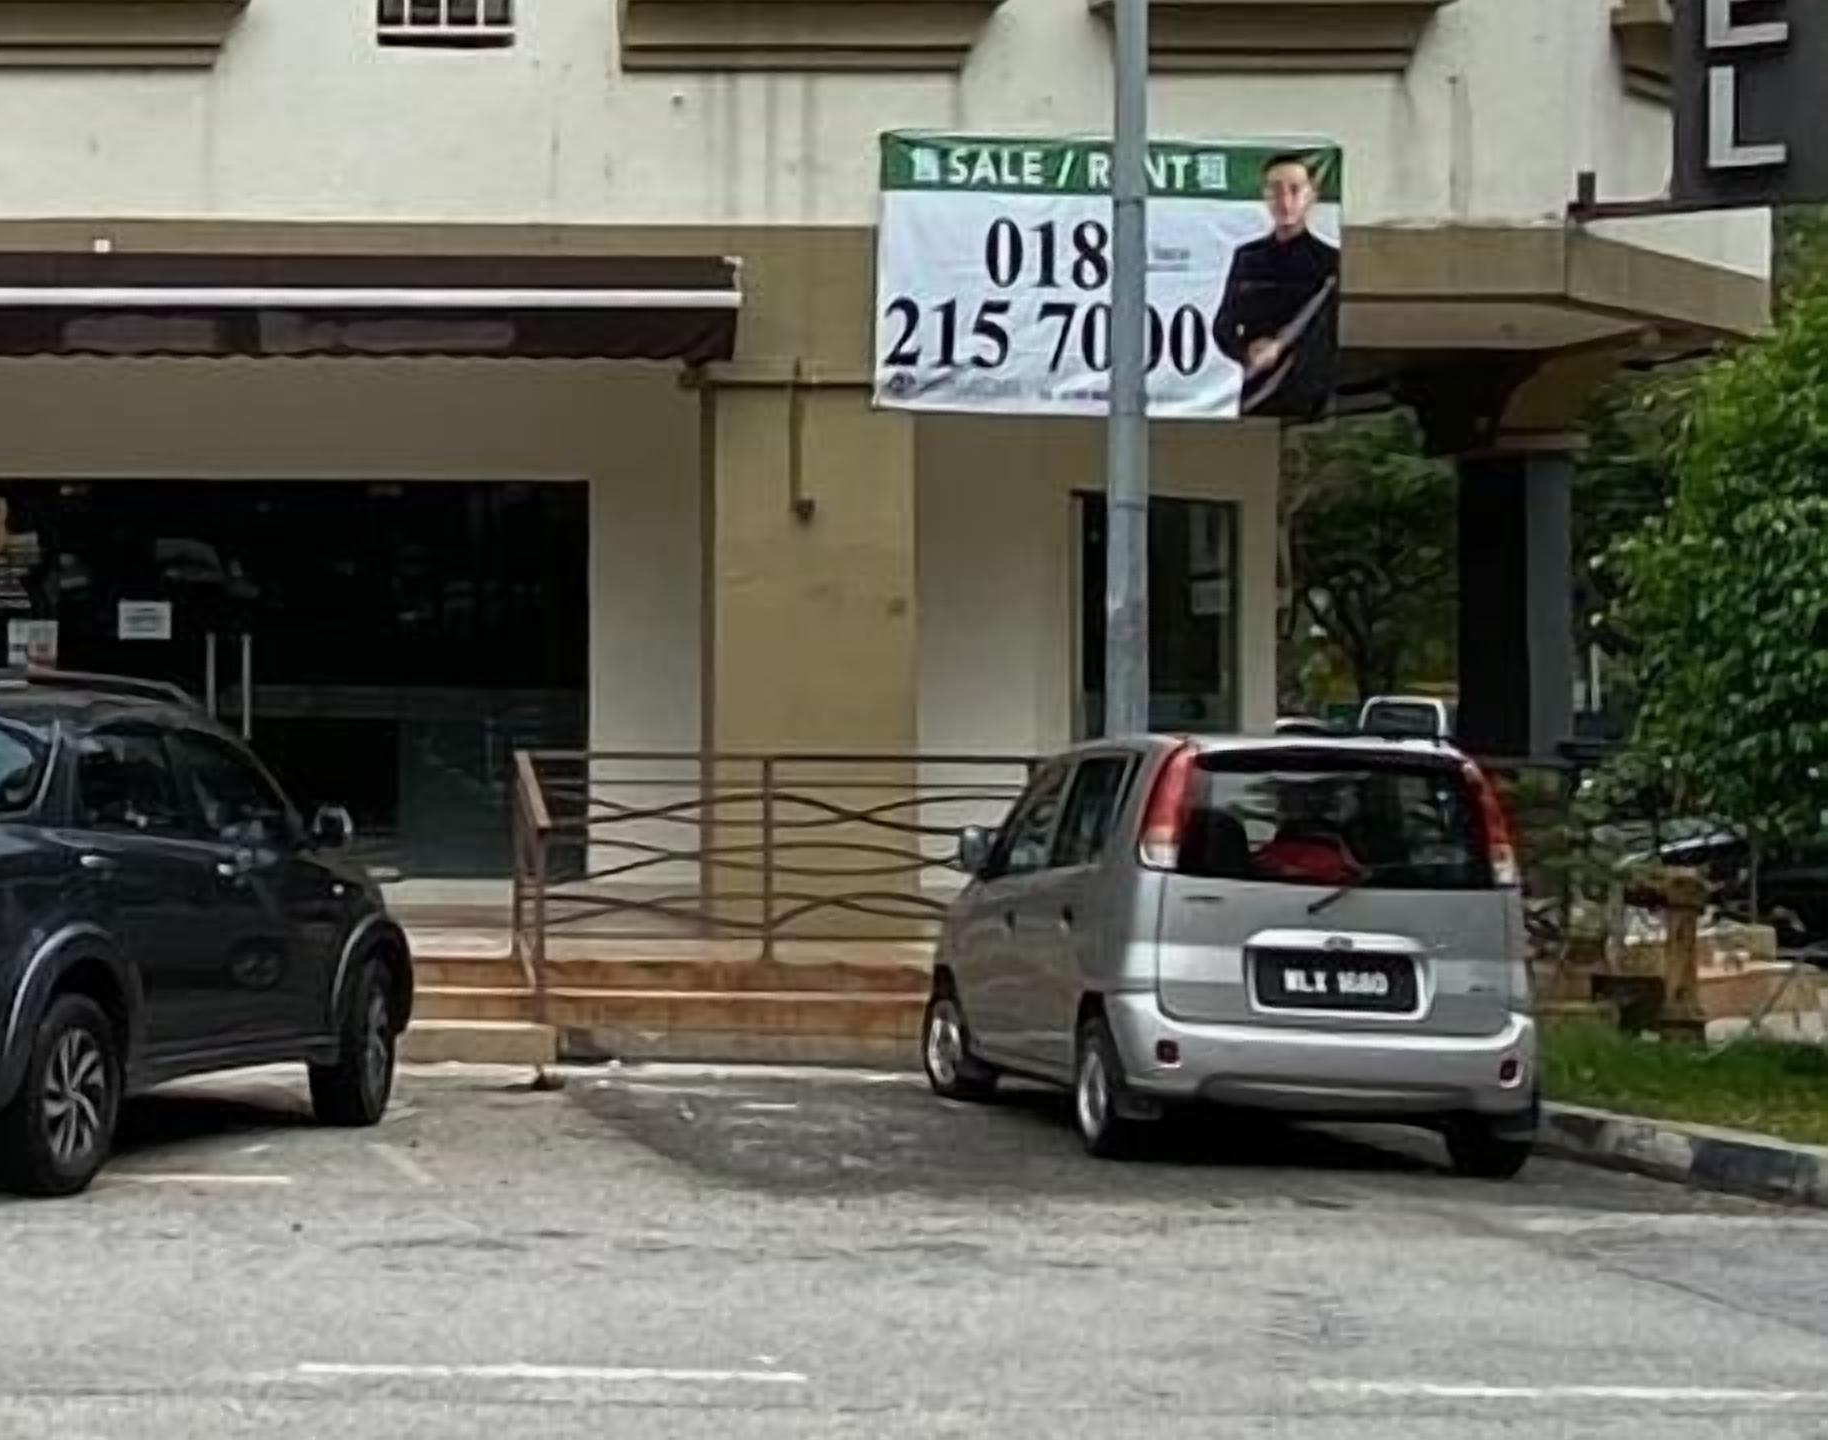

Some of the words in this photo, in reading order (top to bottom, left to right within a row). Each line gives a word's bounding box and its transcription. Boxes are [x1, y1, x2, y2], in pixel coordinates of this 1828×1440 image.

[947, 148, 1045, 186] SALE
[1087, 153, 1192, 189] RNT
[985, 217, 1110, 290] 018
[883, 296, 1010, 369] 215
